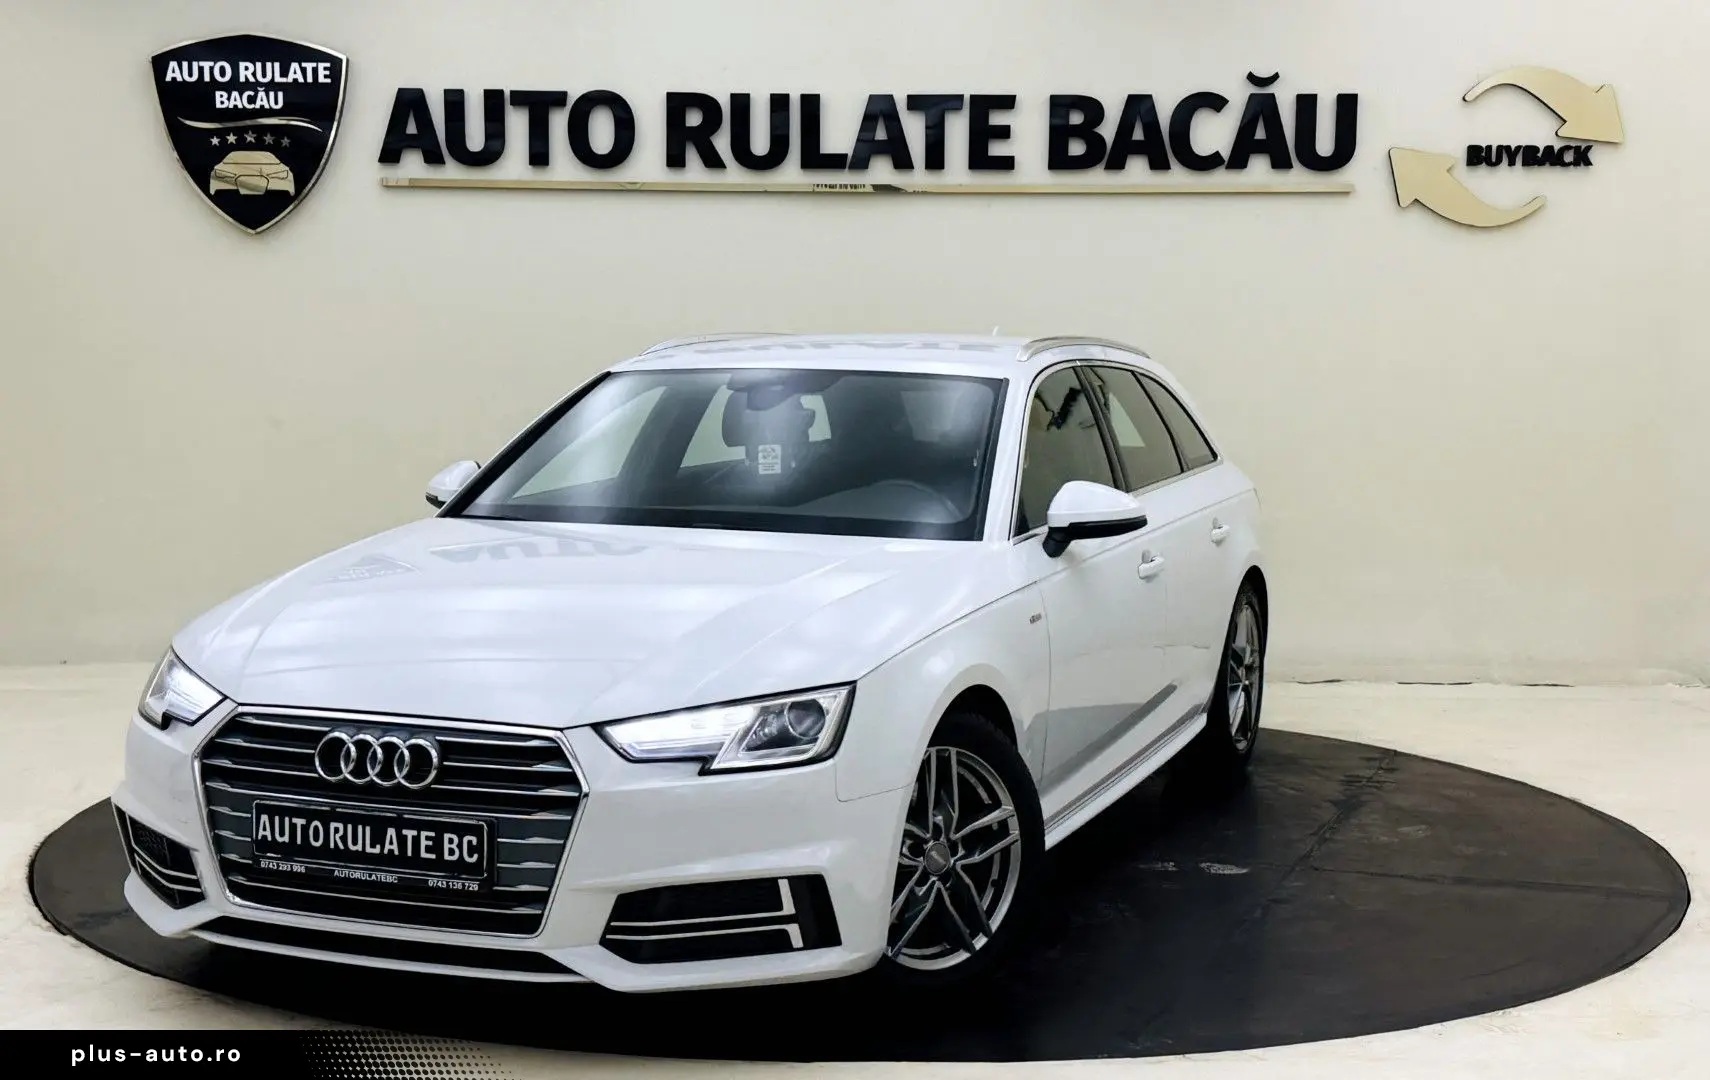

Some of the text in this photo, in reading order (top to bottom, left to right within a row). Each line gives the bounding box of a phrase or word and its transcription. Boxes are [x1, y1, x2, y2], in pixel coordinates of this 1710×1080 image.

[165, 60, 332, 84] AUTO RULATE
[214, 87, 284, 109] BACĂU
[378, 71, 1358, 172] AUTO RULATE BACĂU
[1465, 145, 1593, 167] BUYBACK
[443, 832, 479, 863] BC
[334, 869, 399, 883] AUTORULATEBC
